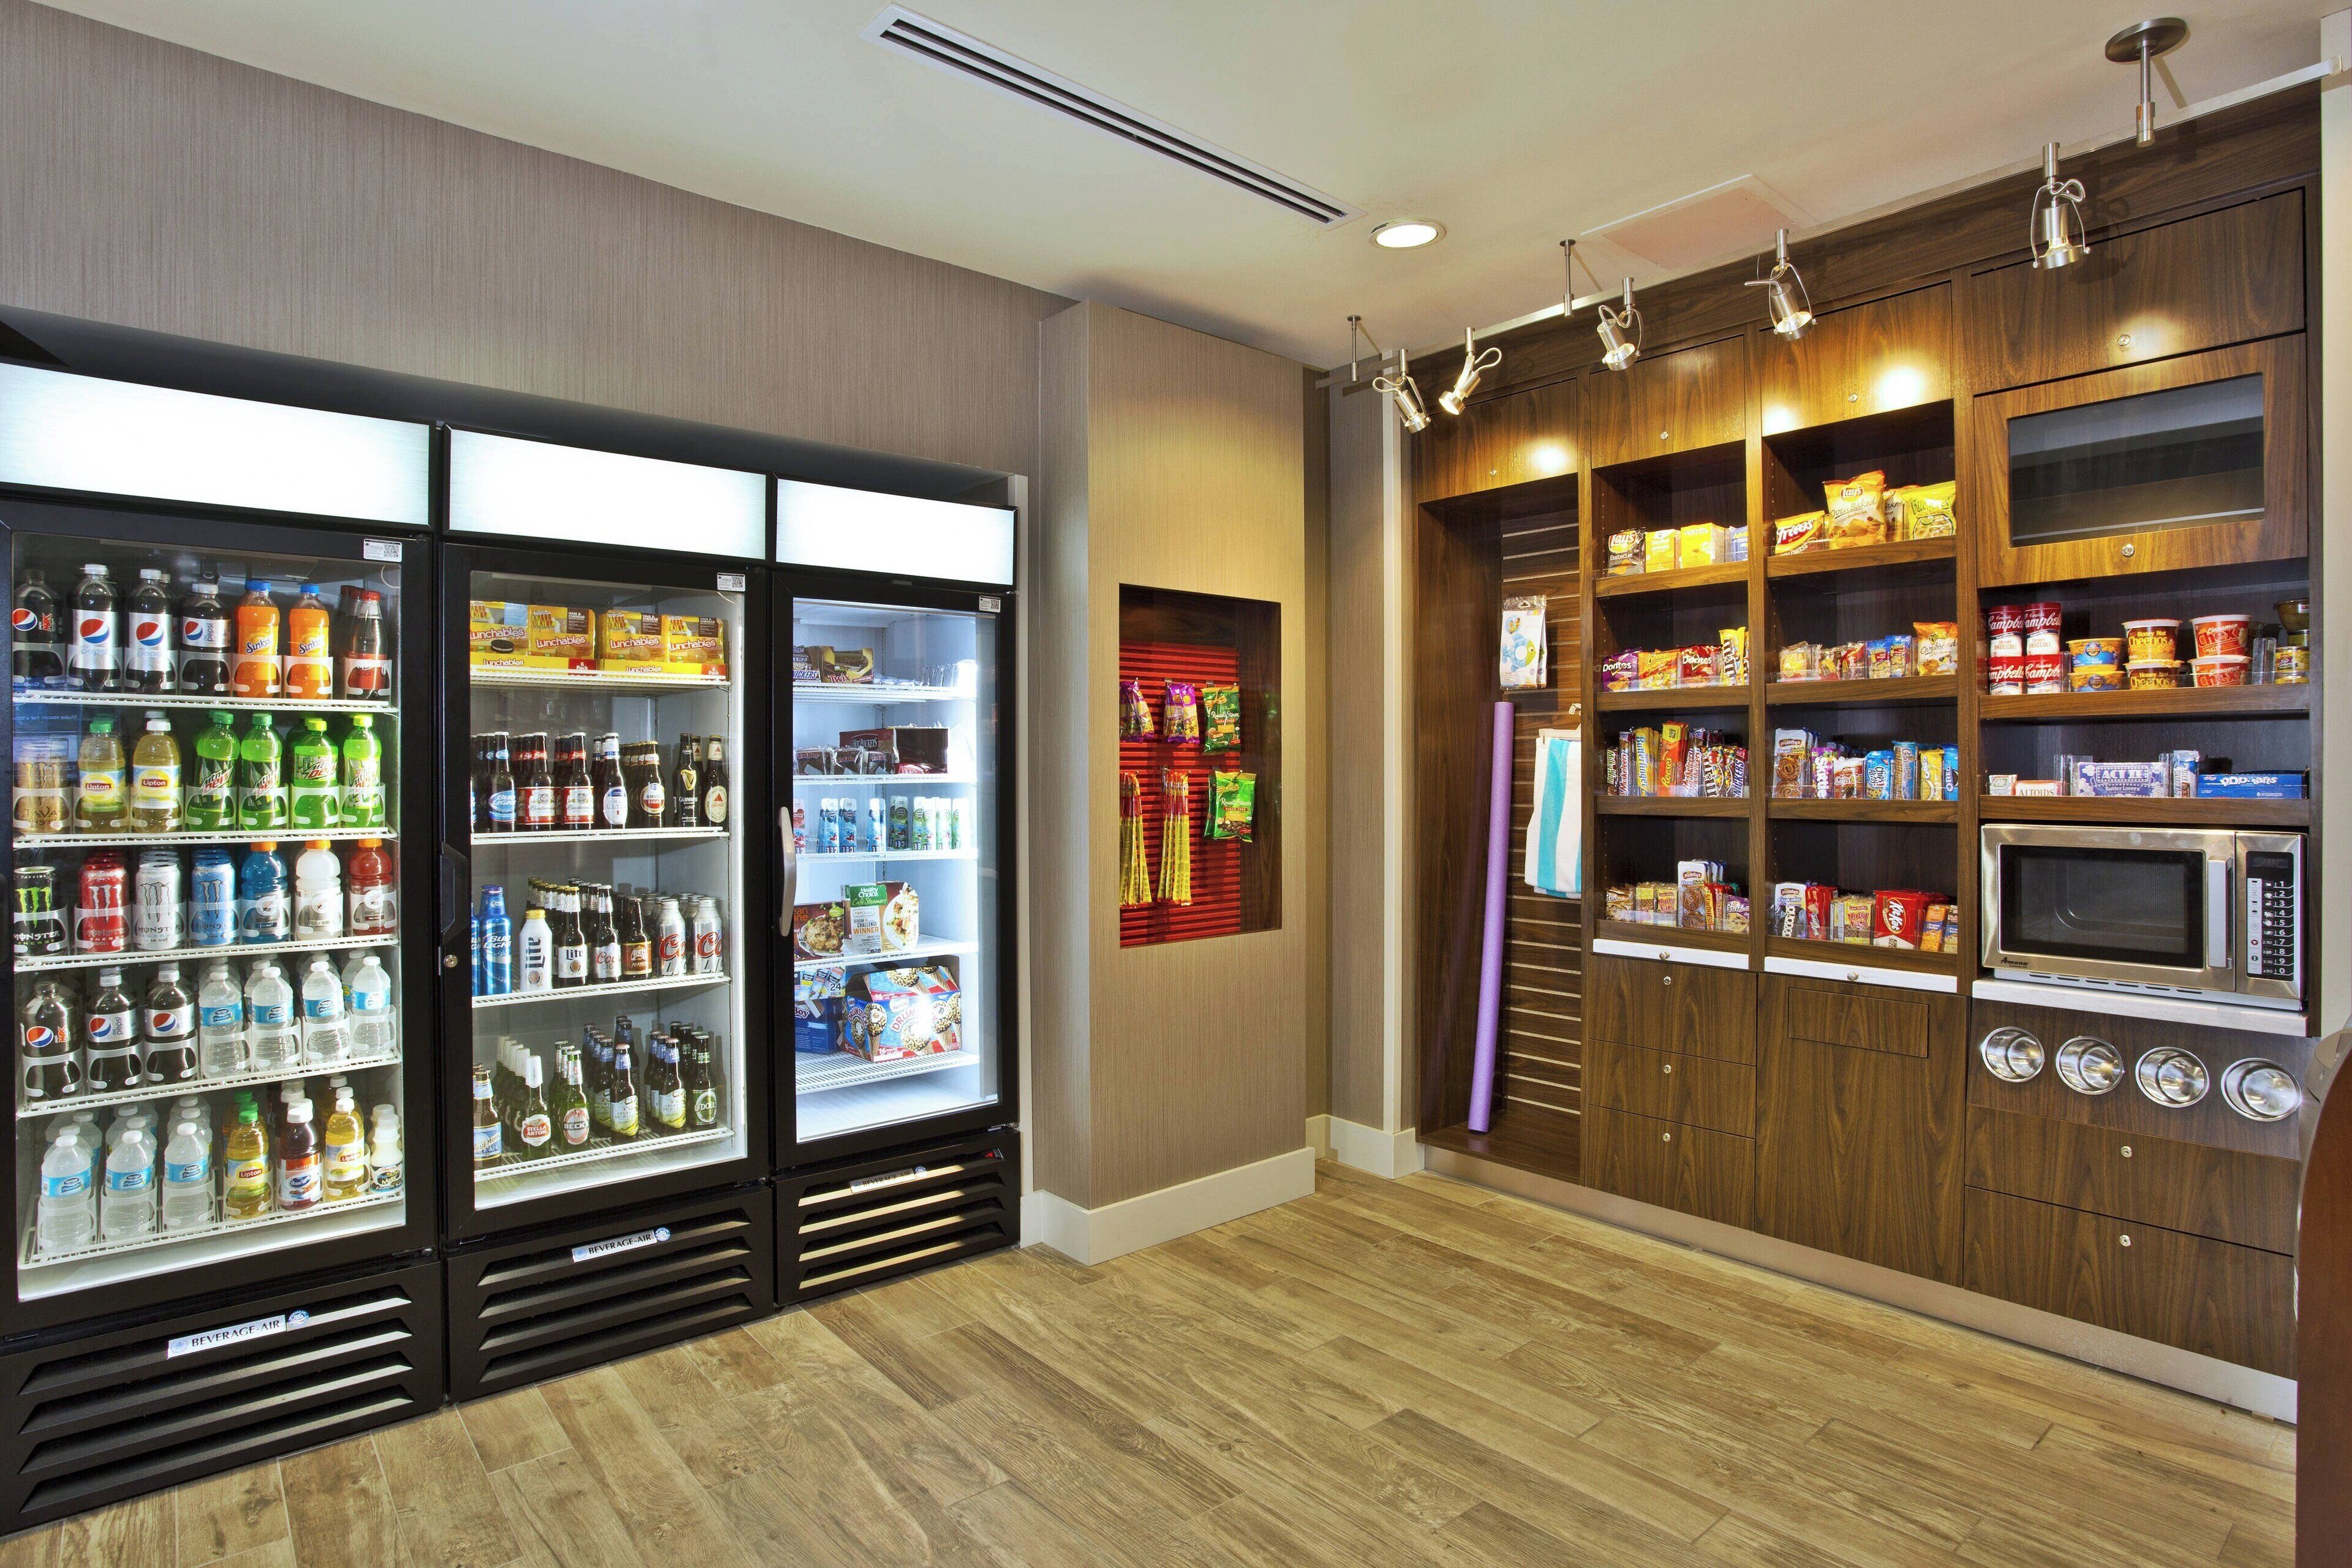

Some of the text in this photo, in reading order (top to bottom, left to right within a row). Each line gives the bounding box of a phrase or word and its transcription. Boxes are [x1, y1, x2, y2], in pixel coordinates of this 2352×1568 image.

[536, 636, 586, 649] Lunchables
[609, 636, 660, 650] Lunchables
[2128, 635, 2168, 647] Cheerios
[2197, 630, 2237, 647] Chex
[669, 639, 717, 651] Lunchables
[1682, 655, 1713, 665] Doritos
[1603, 662, 1632, 672] Doritos
[827, 673, 851, 683] Twix
[2130, 676, 2170, 687] Cheerios
[2198, 672, 2238, 687] Chex
[1636, 736, 1648, 788] Butterfinger
[1874, 766, 1885, 783] Chips
[1945, 766, 1954, 793] OREO
[2101, 769, 2142, 779] ACT II
[86, 783, 110, 791] Lipton
[143, 779, 167, 788] Lipton
[1220, 797, 1236, 807] Russell
[137, 925, 180, 934] MONSTR
[13, 930, 59, 941] MONSTER
[526, 937, 546, 970] Lite
[2000, 956, 2029, 966] Amana
[830, 982, 842, 991] 24
[239, 1168, 263, 1178] Lipton
[862, 1170, 911, 1187] BEVERAGEAIR
[589, 1234, 651, 1254] BEVERAGE-AIR
[192, 1320, 280, 1348] BEVERAGE-AIR
